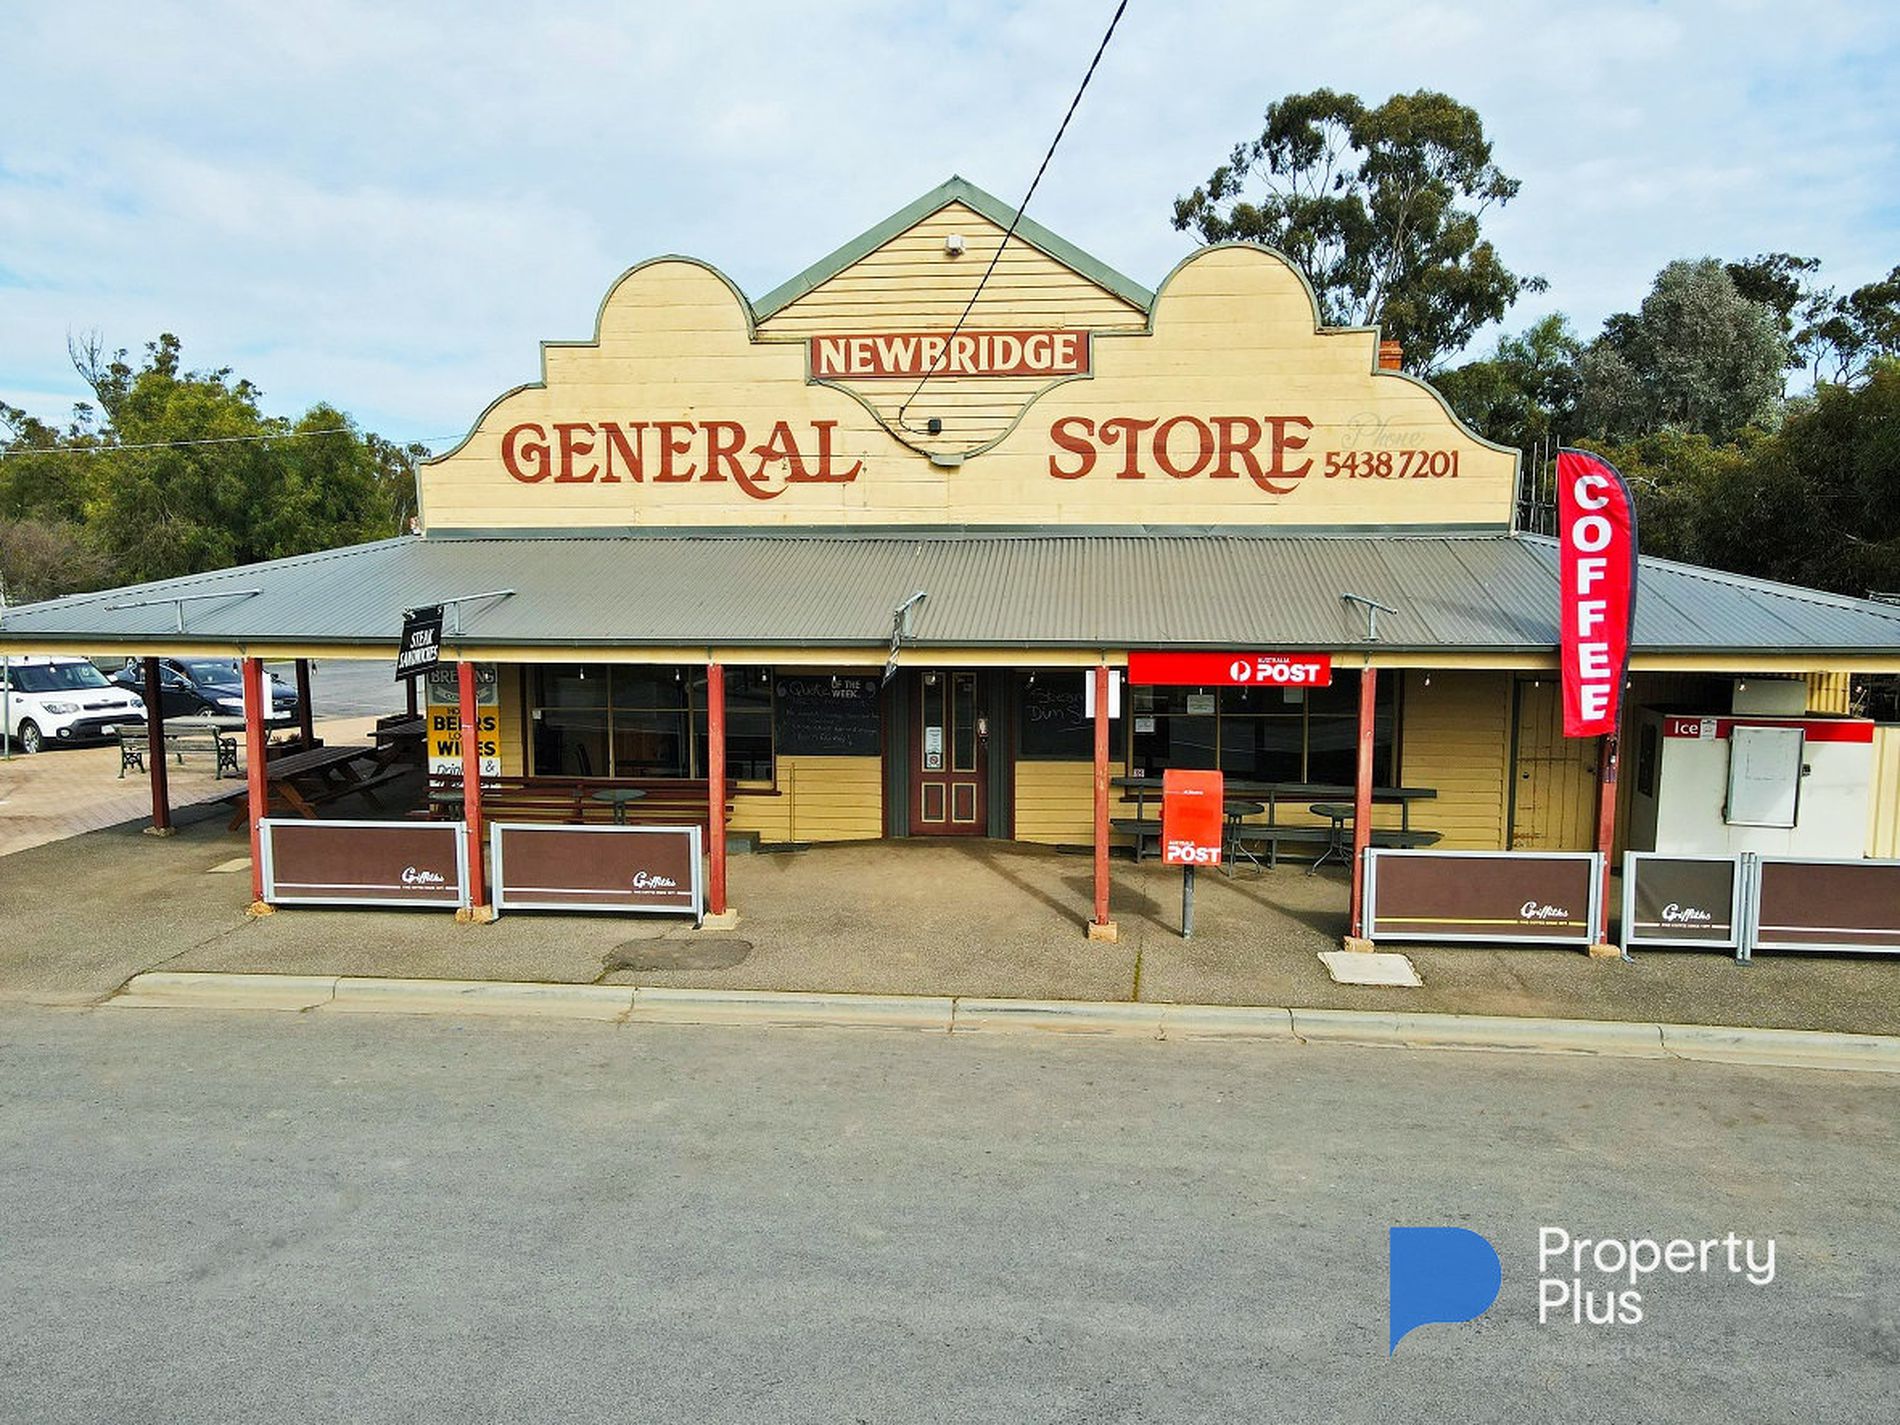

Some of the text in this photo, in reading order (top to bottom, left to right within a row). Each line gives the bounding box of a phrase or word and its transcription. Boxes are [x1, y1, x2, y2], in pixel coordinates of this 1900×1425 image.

[819, 334, 1078, 374] NEWBRIDGE
[1341, 411, 1426, 449] Phone
[501, 415, 1314, 499] GENERAL STORE
[1324, 450, 1459, 478] 5438 7201
[1572, 475, 1613, 721] COFFEE
[410, 627, 436, 649] STEAK
[844, 680, 861, 689] THE
[1256, 664, 1321, 682] POST
[1674, 720, 1699, 735] Ice
[1167, 846, 1222, 863] POST
